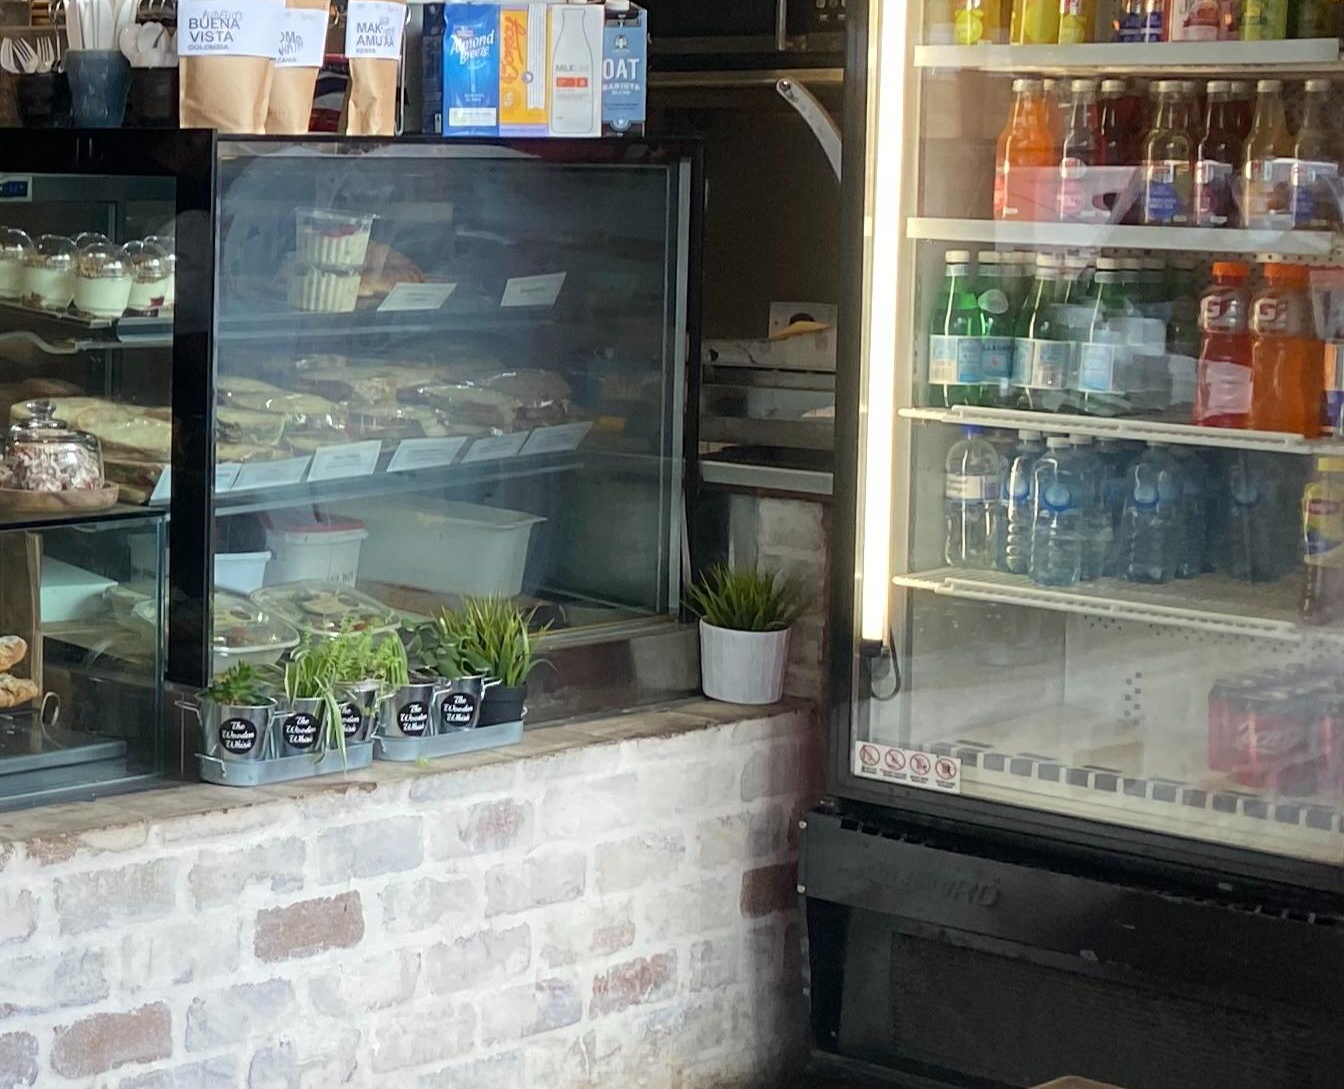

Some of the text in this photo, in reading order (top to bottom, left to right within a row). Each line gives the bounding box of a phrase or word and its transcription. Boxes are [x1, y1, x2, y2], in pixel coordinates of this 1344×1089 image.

[188, 18, 240, 30] BUENA
[190, 30, 234, 43] VISTA
[450, 30, 495, 56] Almond
[460, 46, 490, 64] Breeze
[602, 59, 640, 80] OAT
[454, 695, 467, 704] The
[409, 704, 422, 713] The
[231, 721, 246, 730] The
[295, 716, 310, 725] The
